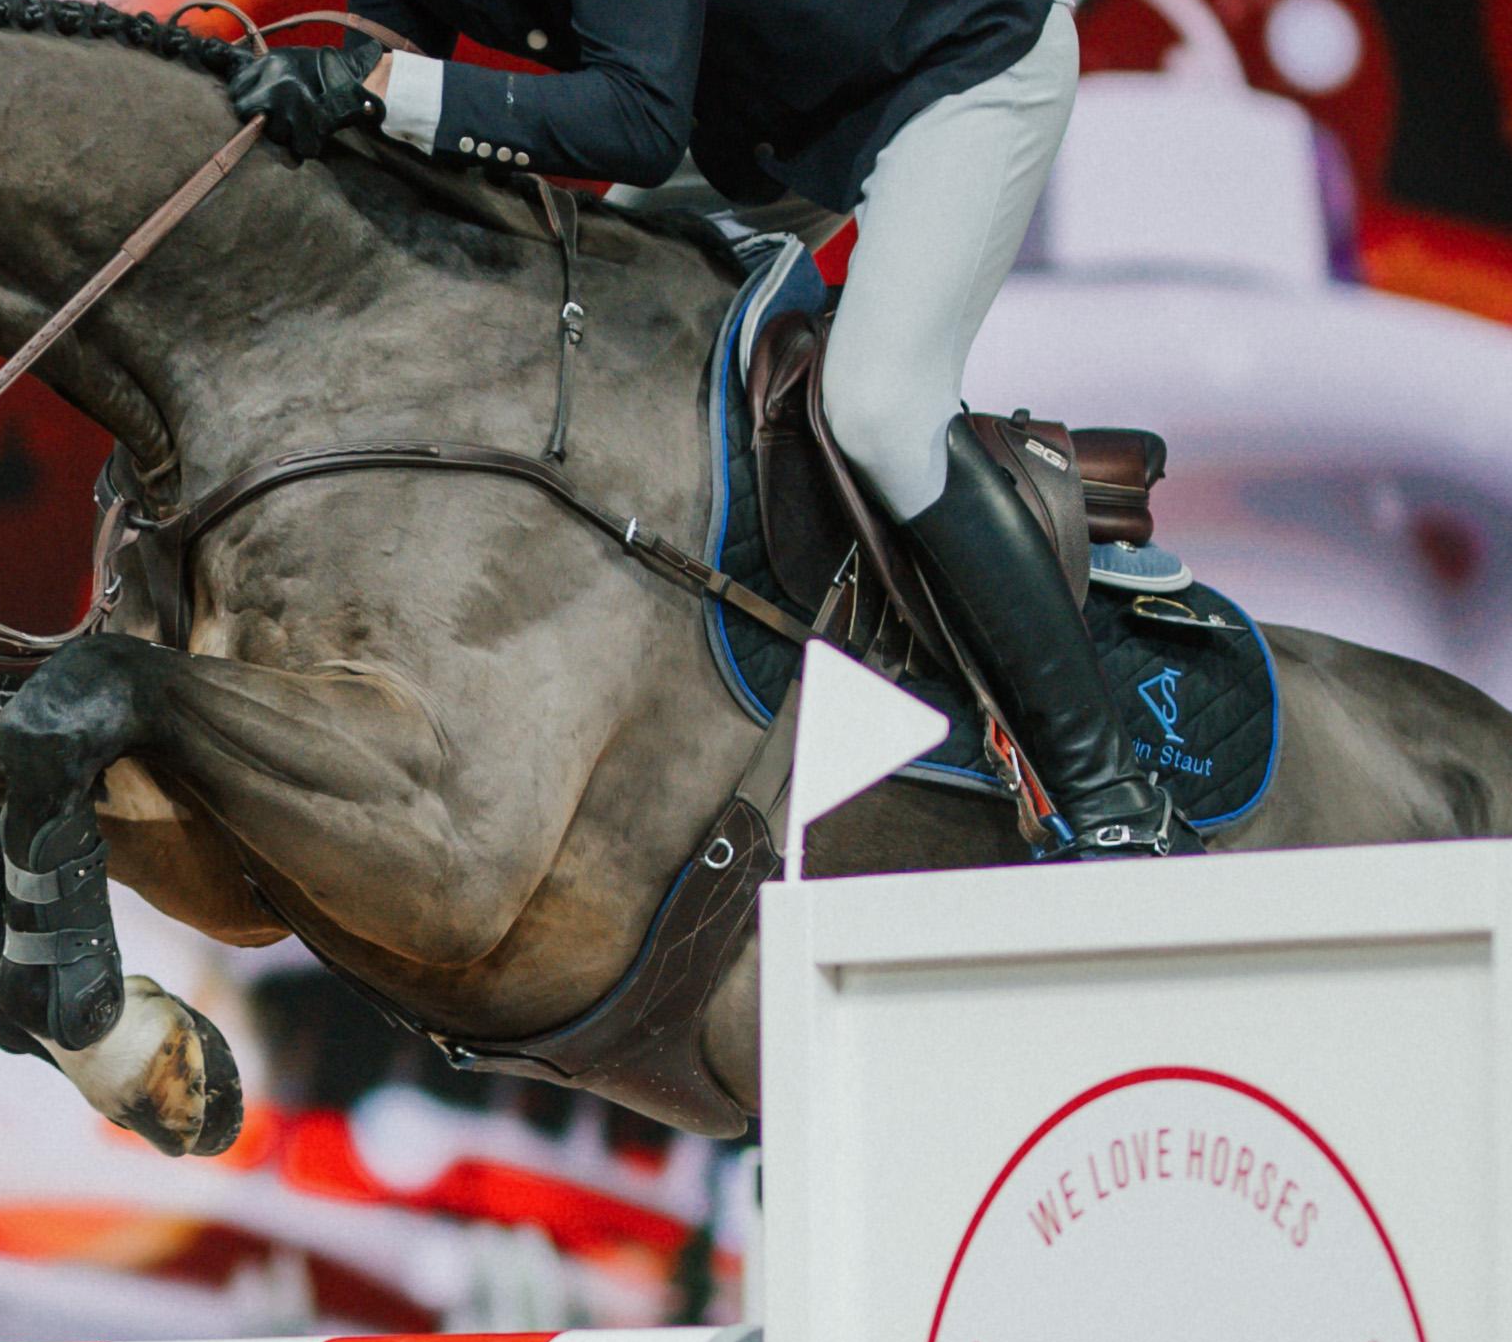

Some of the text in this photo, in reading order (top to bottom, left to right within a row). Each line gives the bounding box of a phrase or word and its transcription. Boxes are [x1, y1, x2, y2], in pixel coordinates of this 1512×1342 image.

[1160, 745, 1213, 777] Staut
[1028, 1128, 1318, 1248] WE LOVE HORSES
